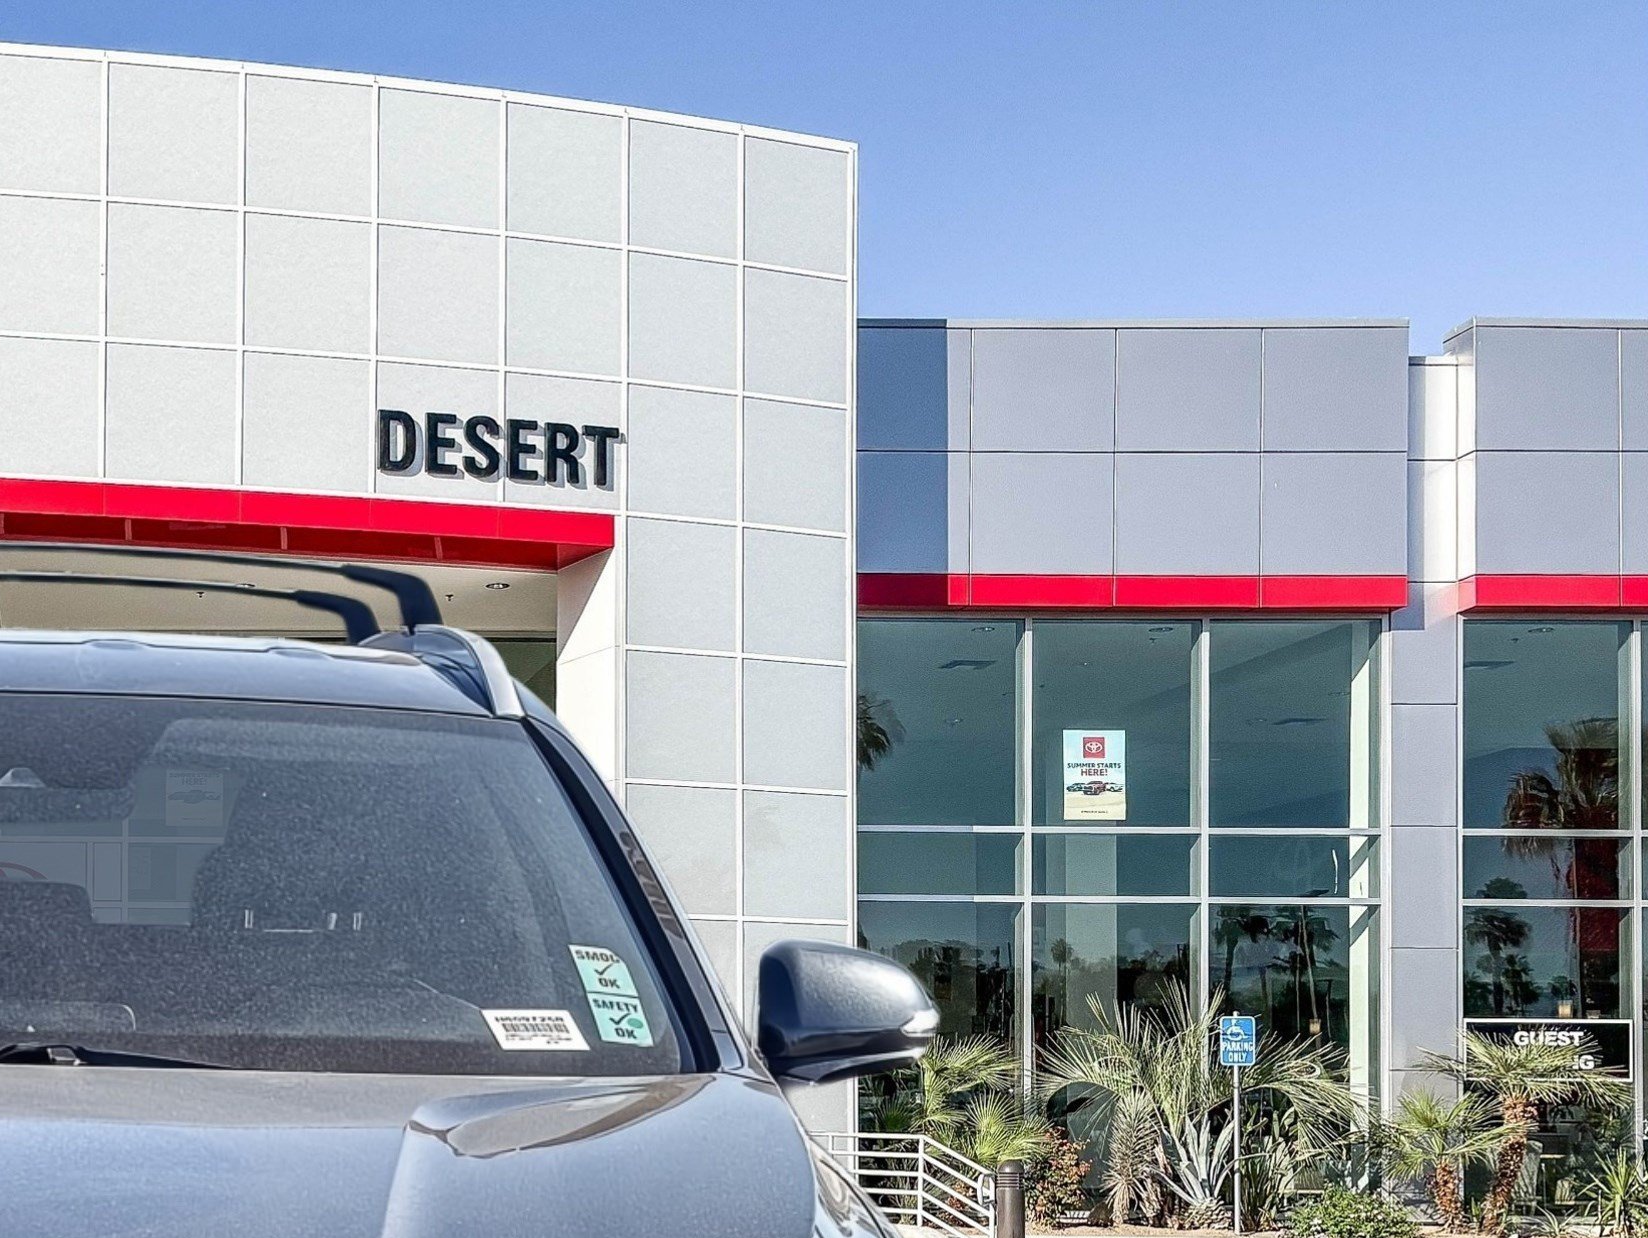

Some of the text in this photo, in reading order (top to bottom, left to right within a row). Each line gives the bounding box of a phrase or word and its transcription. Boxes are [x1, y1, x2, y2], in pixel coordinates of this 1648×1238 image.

[377, 409, 620, 487] DESERT
[598, 978, 620, 989] OK
[592, 998, 638, 1012] SAFETY
[614, 1028, 637, 1039] OK
[1513, 1031, 1584, 1047] GUEST
[1222, 1041, 1253, 1052] PARKING
[1228, 1052, 1247, 1062] ONLY
